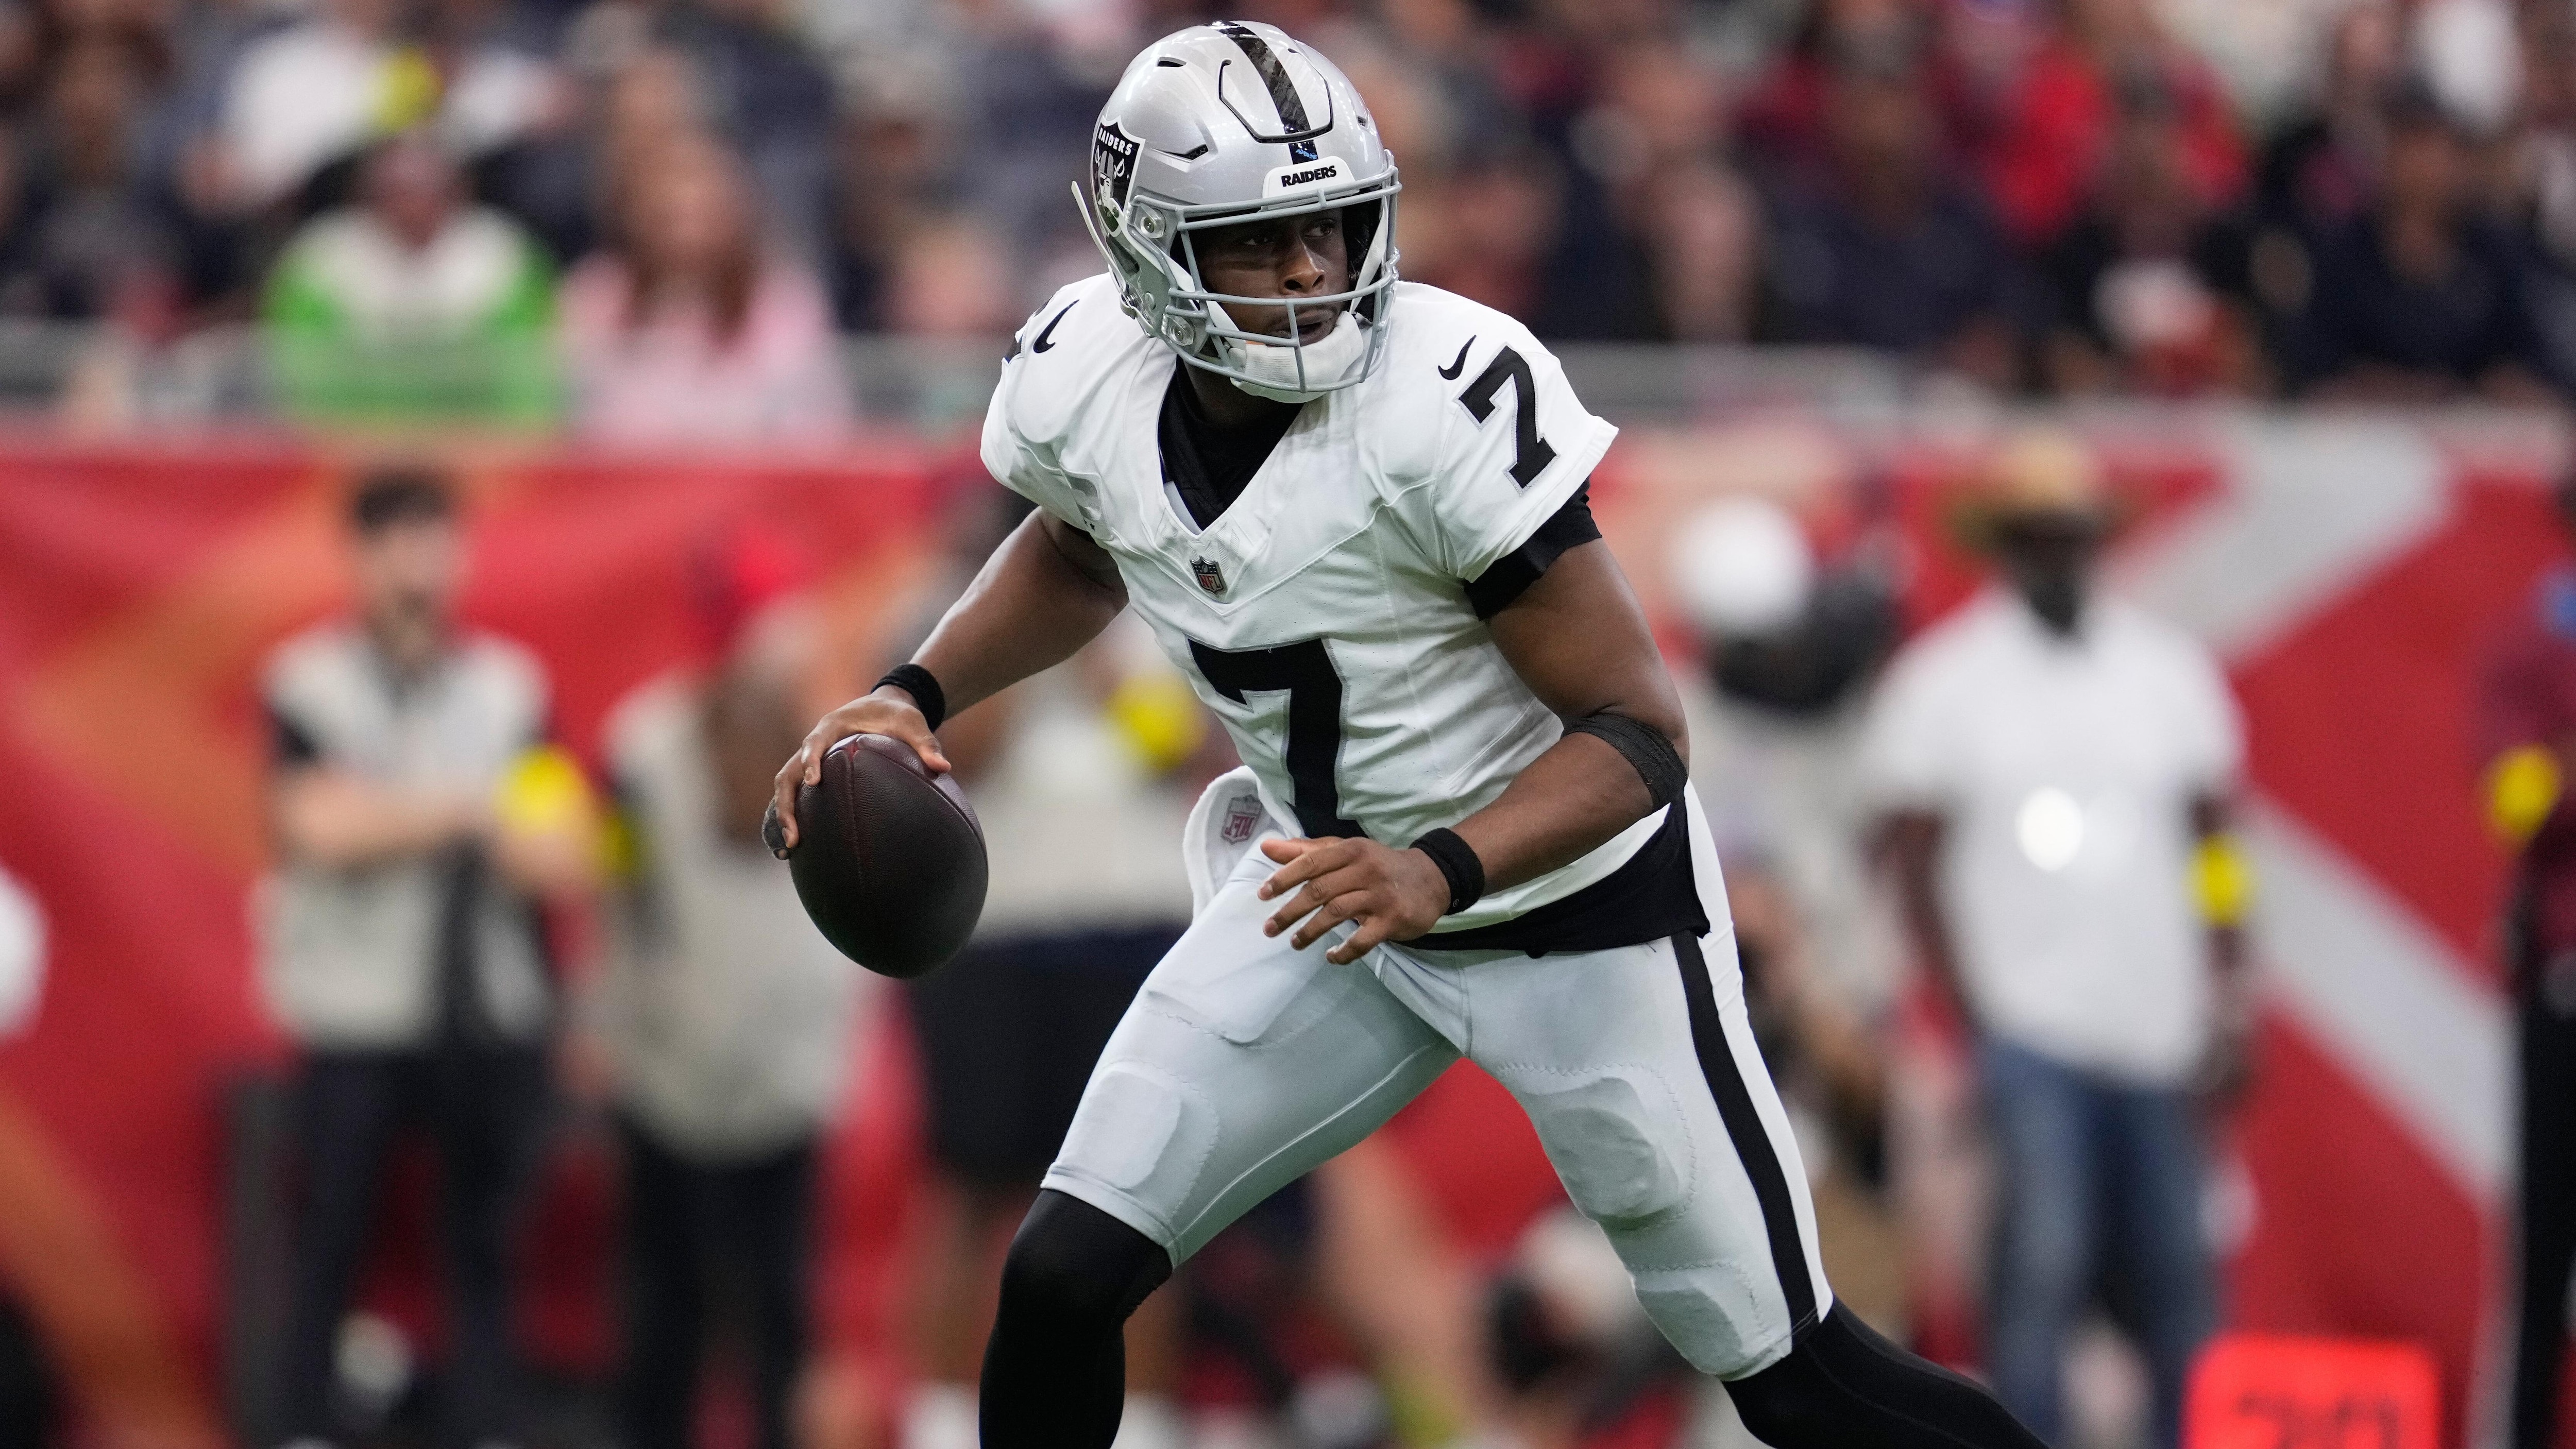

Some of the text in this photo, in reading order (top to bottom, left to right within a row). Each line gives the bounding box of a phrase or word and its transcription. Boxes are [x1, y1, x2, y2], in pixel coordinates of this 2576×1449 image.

[1098, 127, 1132, 156] RAIDERS
[1281, 165, 1336, 187] RAIDERS
[1454, 343, 1560, 492] 7
[1186, 635, 1371, 839] 7
